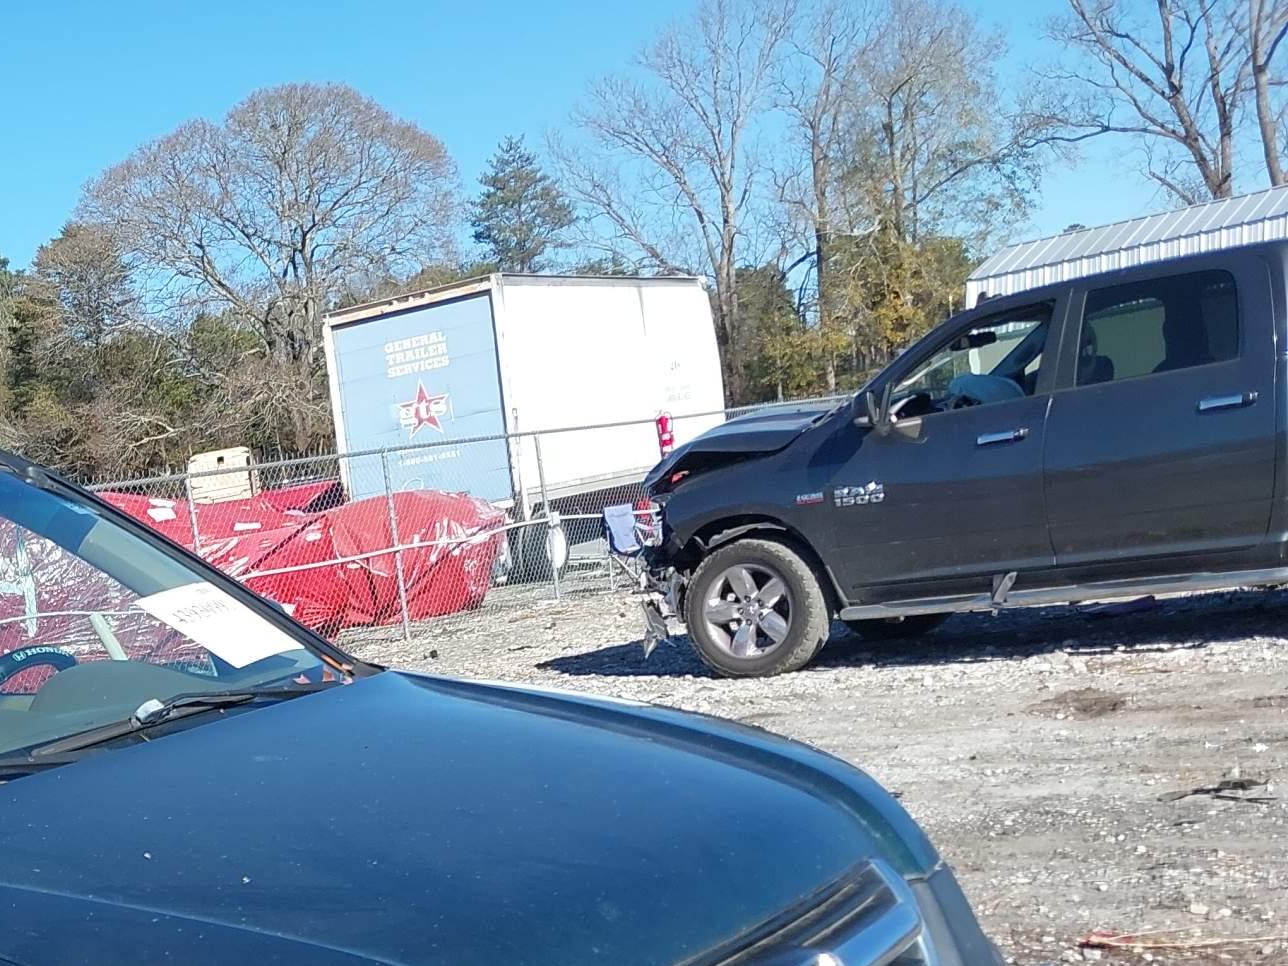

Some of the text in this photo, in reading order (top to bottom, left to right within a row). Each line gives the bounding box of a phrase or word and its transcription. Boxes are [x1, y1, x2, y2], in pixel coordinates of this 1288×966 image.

[384, 331, 447, 353] GENERAL
[386, 342, 448, 365] TRAILER
[387, 355, 450, 378] SERVICES
[834, 481, 883, 498] RAM
[834, 493, 885, 507] 1500
